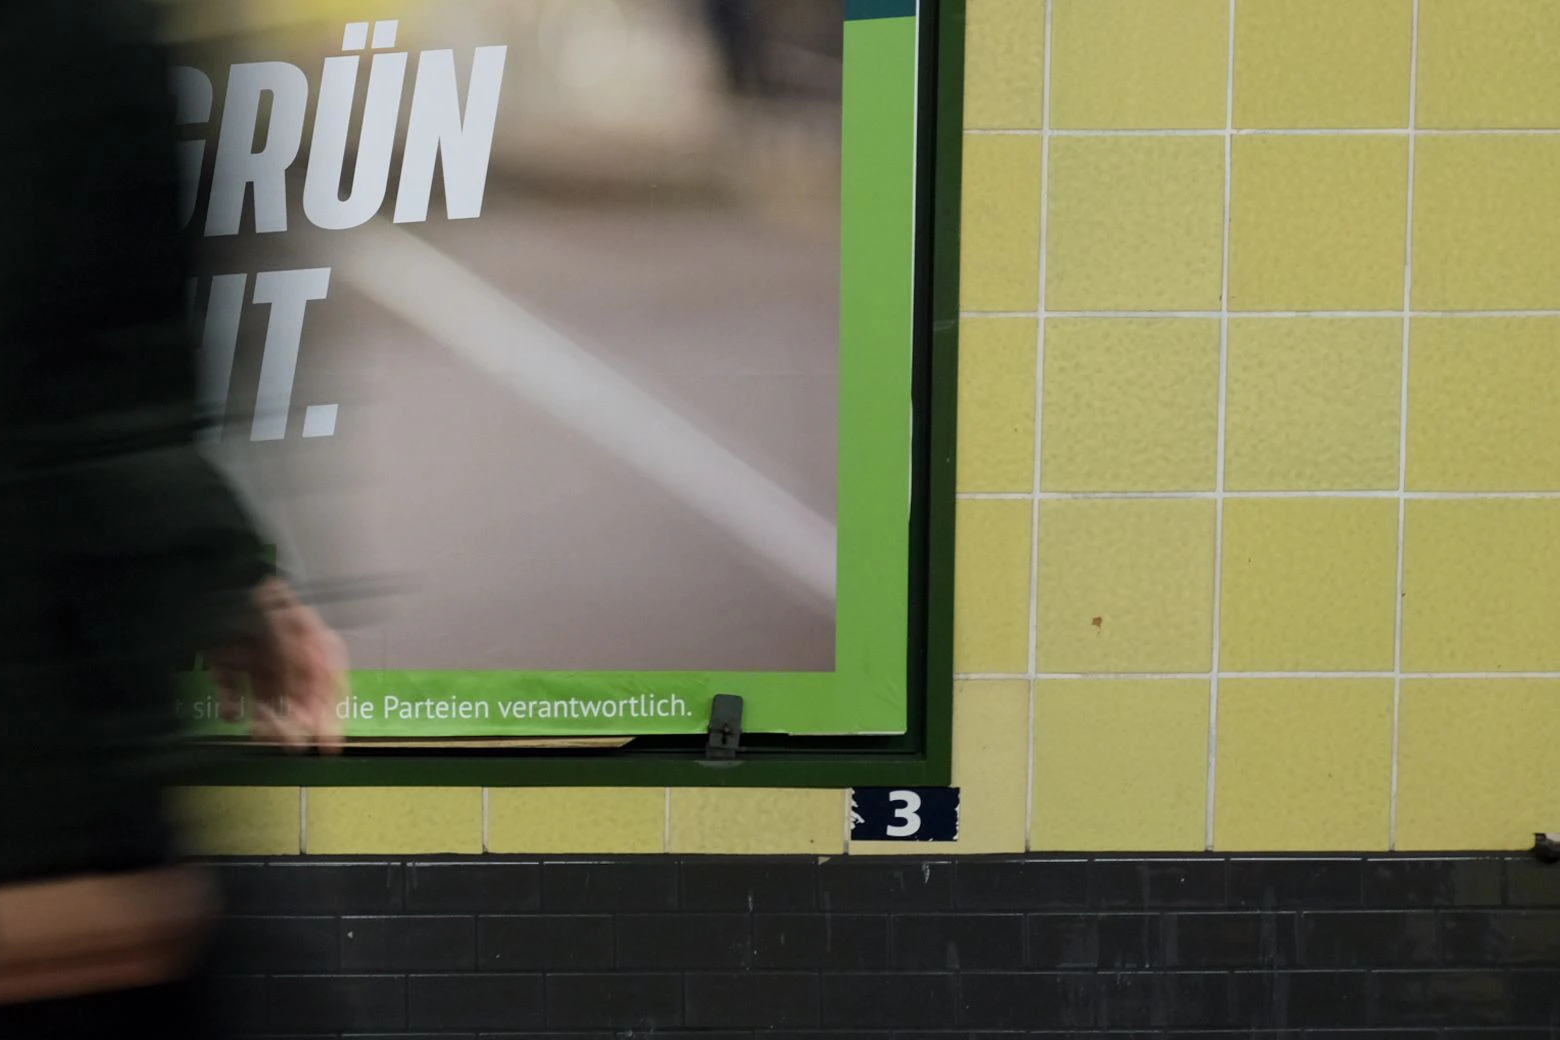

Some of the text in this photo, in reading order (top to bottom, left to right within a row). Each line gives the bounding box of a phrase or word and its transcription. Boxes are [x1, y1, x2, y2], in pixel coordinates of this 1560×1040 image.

[335, 693, 375, 719] die
[383, 695, 490, 719] Parteien
[497, 693, 693, 719] verantwortlich.
[886, 790, 922, 837] 3
